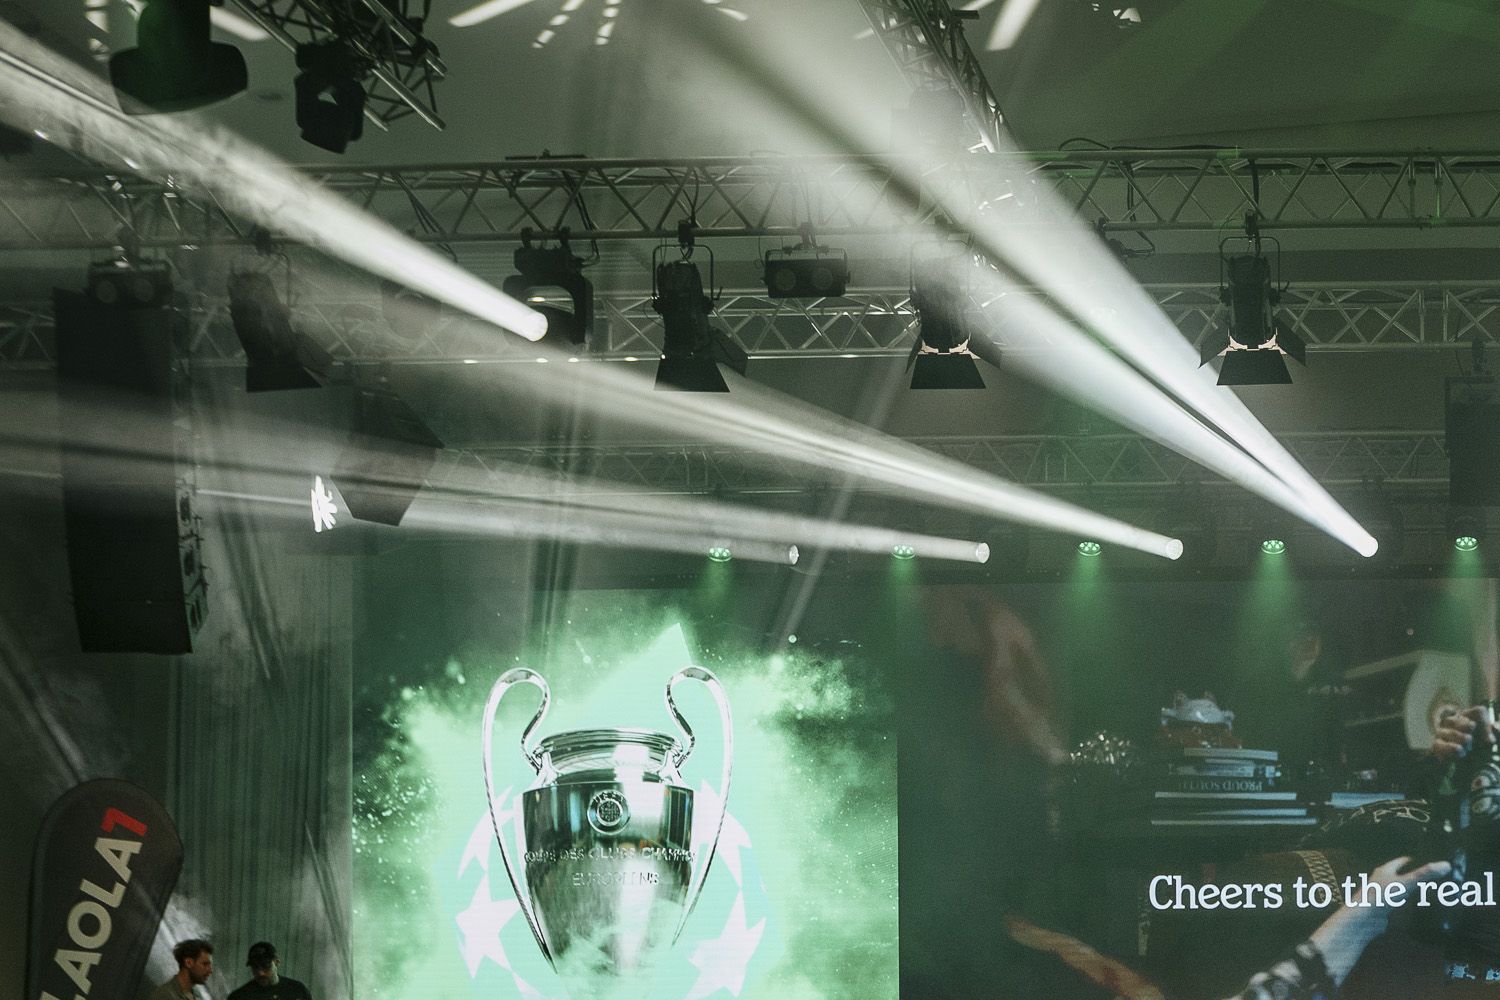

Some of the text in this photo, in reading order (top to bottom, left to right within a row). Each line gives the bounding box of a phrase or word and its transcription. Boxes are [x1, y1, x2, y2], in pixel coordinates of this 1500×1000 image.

[1149, 874, 1283, 909] Cheers
[1293, 876, 1333, 909] to
[1341, 873, 1407, 908] the
[1416, 871, 1497, 908] real
